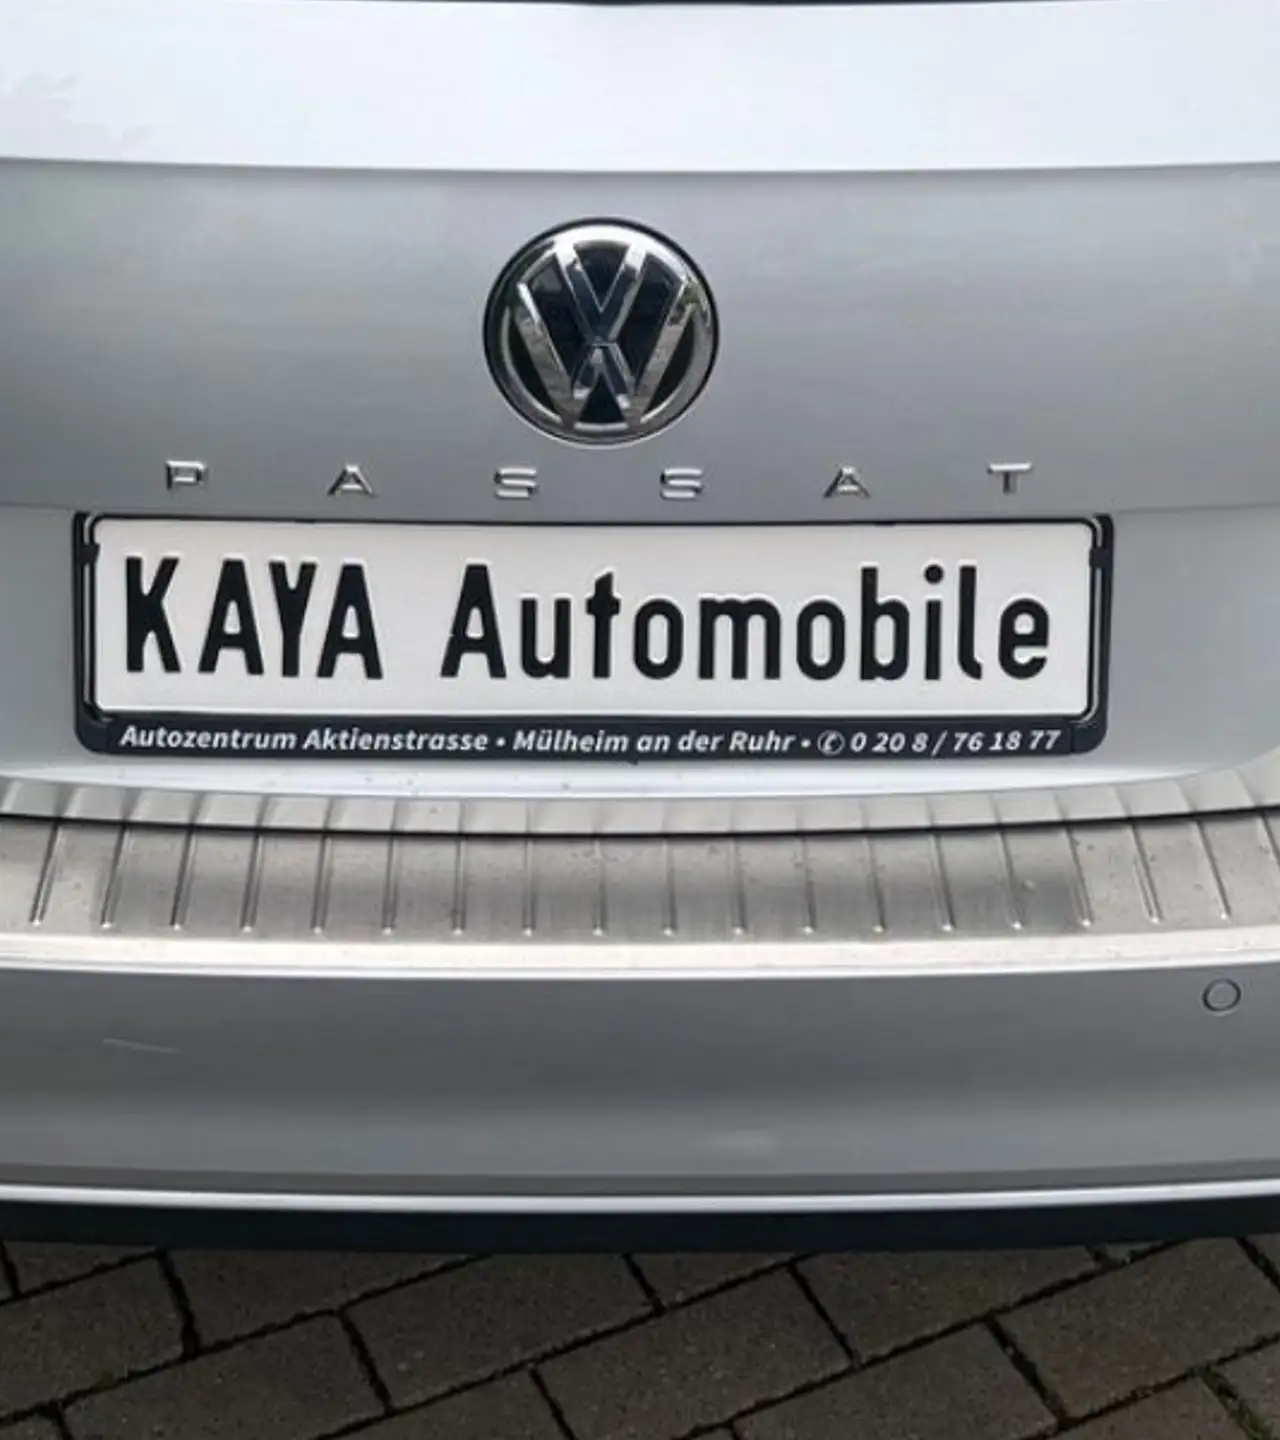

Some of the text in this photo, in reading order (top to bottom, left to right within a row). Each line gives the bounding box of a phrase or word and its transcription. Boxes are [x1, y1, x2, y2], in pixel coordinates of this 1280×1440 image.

[504, 229, 696, 434] VW
[165, 459, 1033, 500] PASSAT
[124, 554, 1051, 682] KAYA Automobile
[120, 724, 297, 750] Autozentrum
[302, 726, 489, 751] Aktienstrasse
[512, 728, 629, 753] Mülheim
[636, 734, 671, 752] an
[677, 728, 723, 752] der
[728, 728, 795, 752] Ruhr
